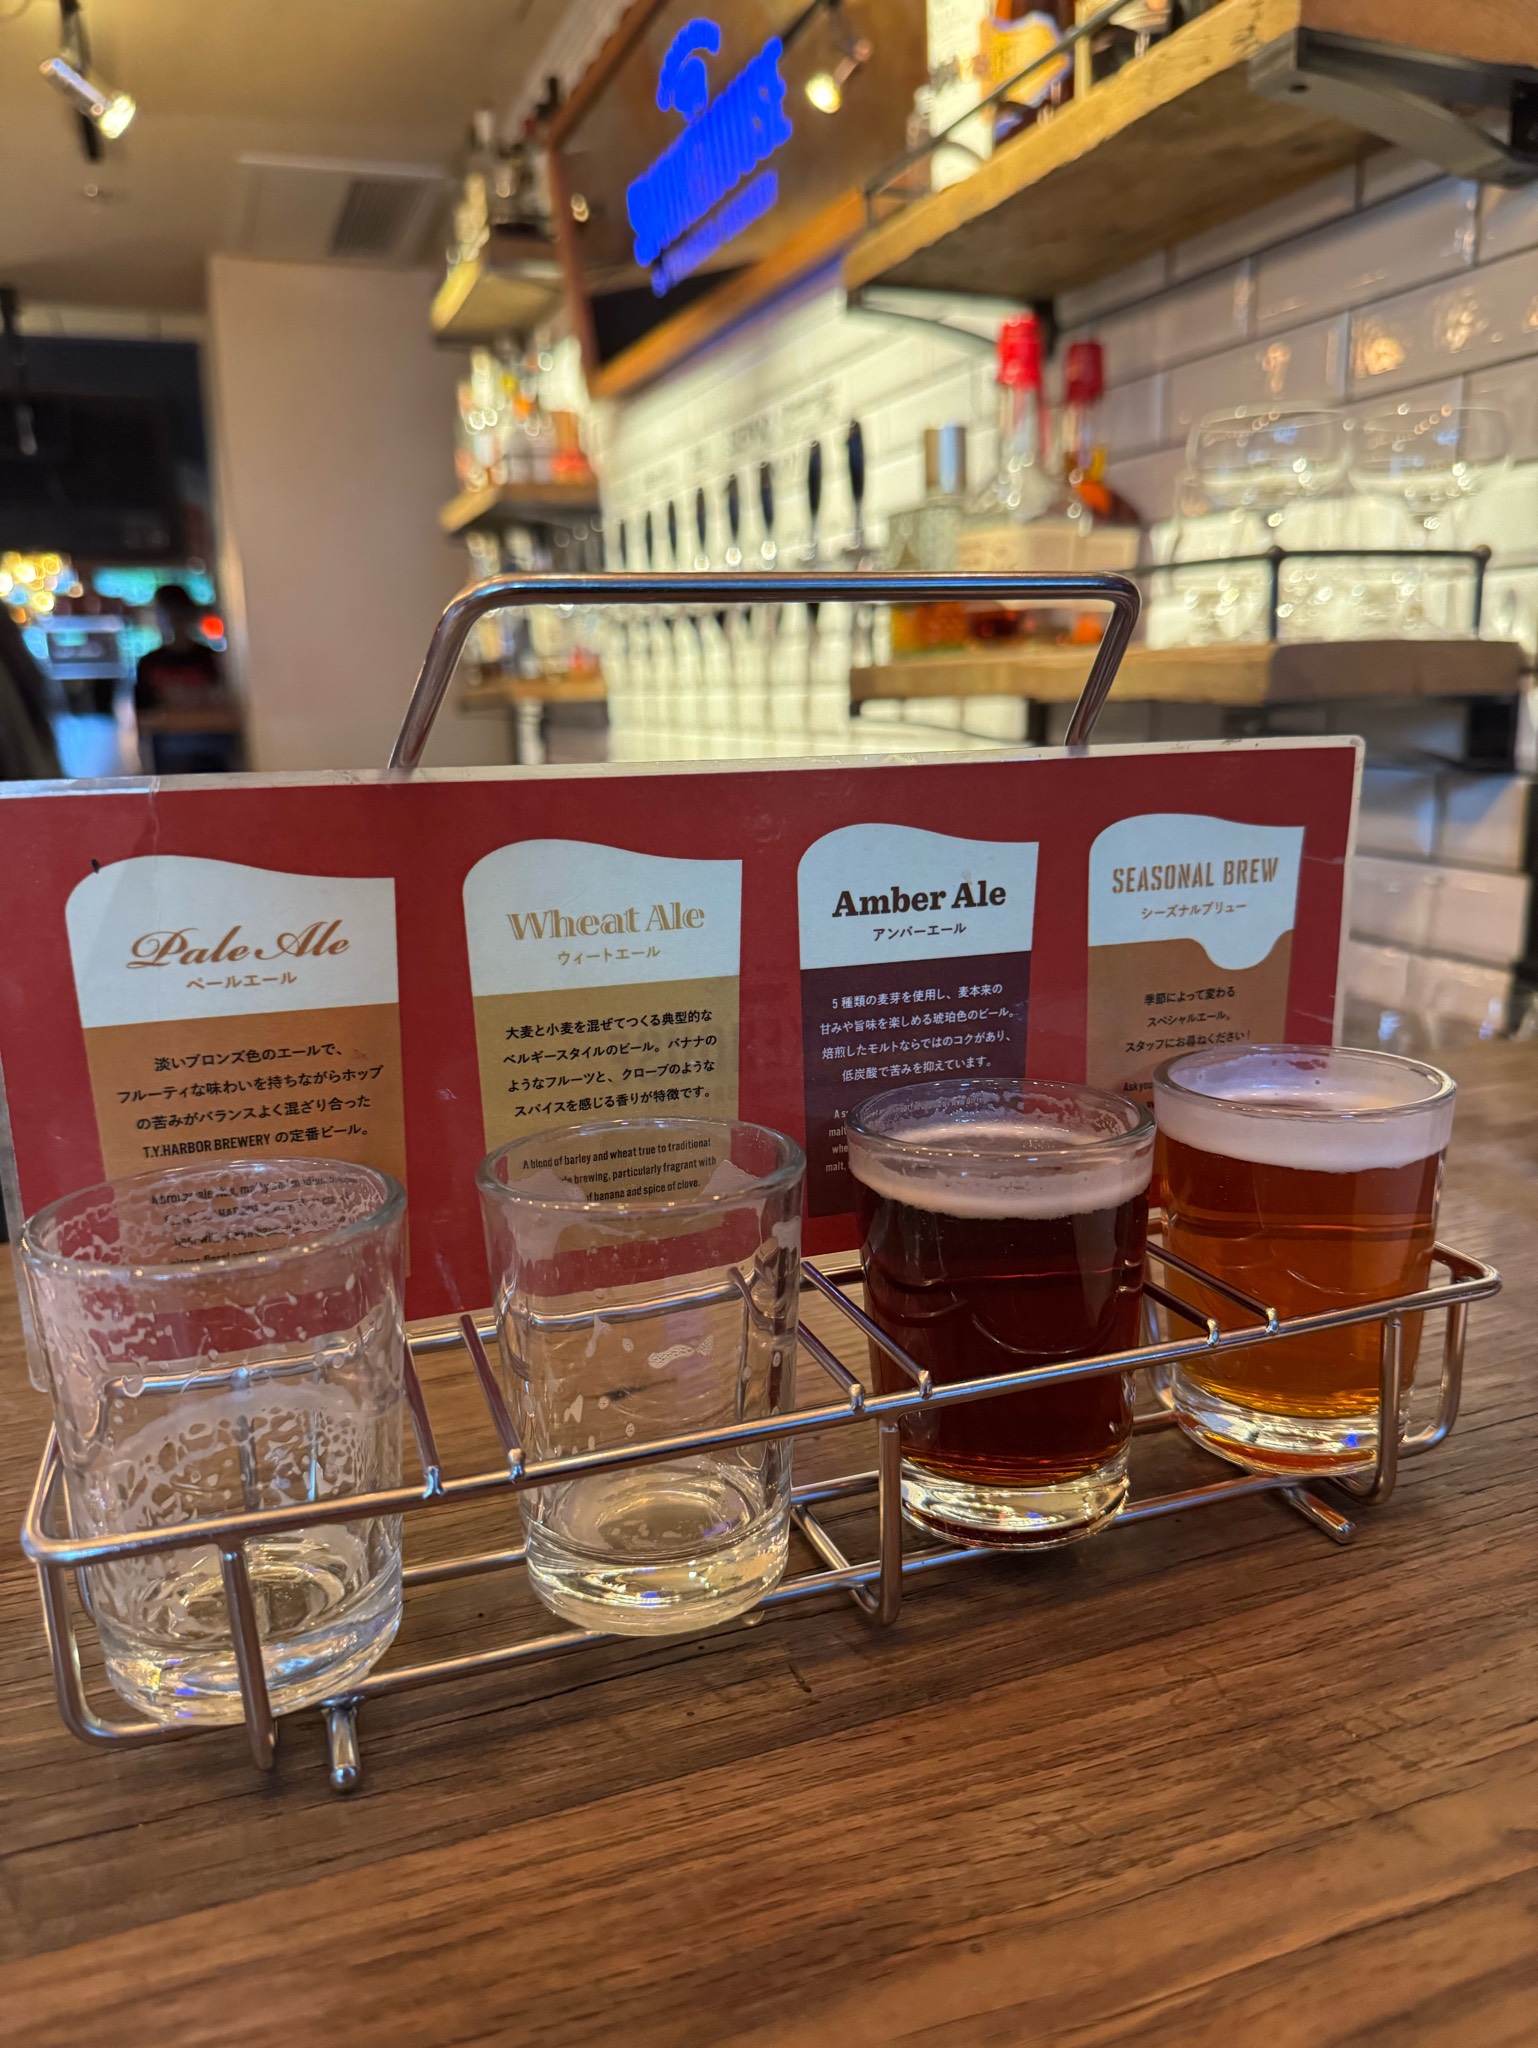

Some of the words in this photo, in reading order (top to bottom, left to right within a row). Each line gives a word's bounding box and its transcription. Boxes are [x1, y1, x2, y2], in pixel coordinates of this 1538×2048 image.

[1111, 862, 1214, 894] SEASONAL
[1223, 857, 1279, 885] BREW
[832, 886, 946, 918] Amber
[951, 880, 1006, 909] Ale
[1141, 901, 1247, 919] シーズナルブリュー
[506, 905, 640, 941] Wheat
[645, 901, 705, 933] Ale
[873, 922, 967, 941] アンバーエール
[126, 925, 250, 969] Pale
[255, 919, 350, 960] Ale
[557, 945, 661, 966] ウィートエール
[186, 971, 298, 990] ペールエール
[1143, 986, 1235, 1006] 季節によって変わる
[1147, 1011, 1231, 1027] スペシャルエール。
[214, 1133, 270, 1150] BREWERY
[275, 1124, 368, 1143] の定番ビール。
[523, 1159, 530, 1170] A
[531, 1157, 552, 1169] blend
[554, 1155, 563, 1167] of
[564, 1153, 591, 1167] barley
[593, 1150, 608, 1162] and
[610, 1148, 637, 1160] wheat
[638, 1145, 656, 1156] true
[657, 1144, 667, 1153] to
[668, 1138, 711, 1152] traditional
[574, 1171, 611, 1185] brewing,
[612, 1163, 661, 1182] particularly
[663, 1159, 697, 1175] fragrant
[699, 1156, 716, 1168] with
[593, 1188, 625, 1201] banana
[626, 1185, 642, 1198] and
[643, 1182, 666, 1197] spice
[667, 1181, 676, 1192] of
[677, 1177, 701, 1191] clove.
